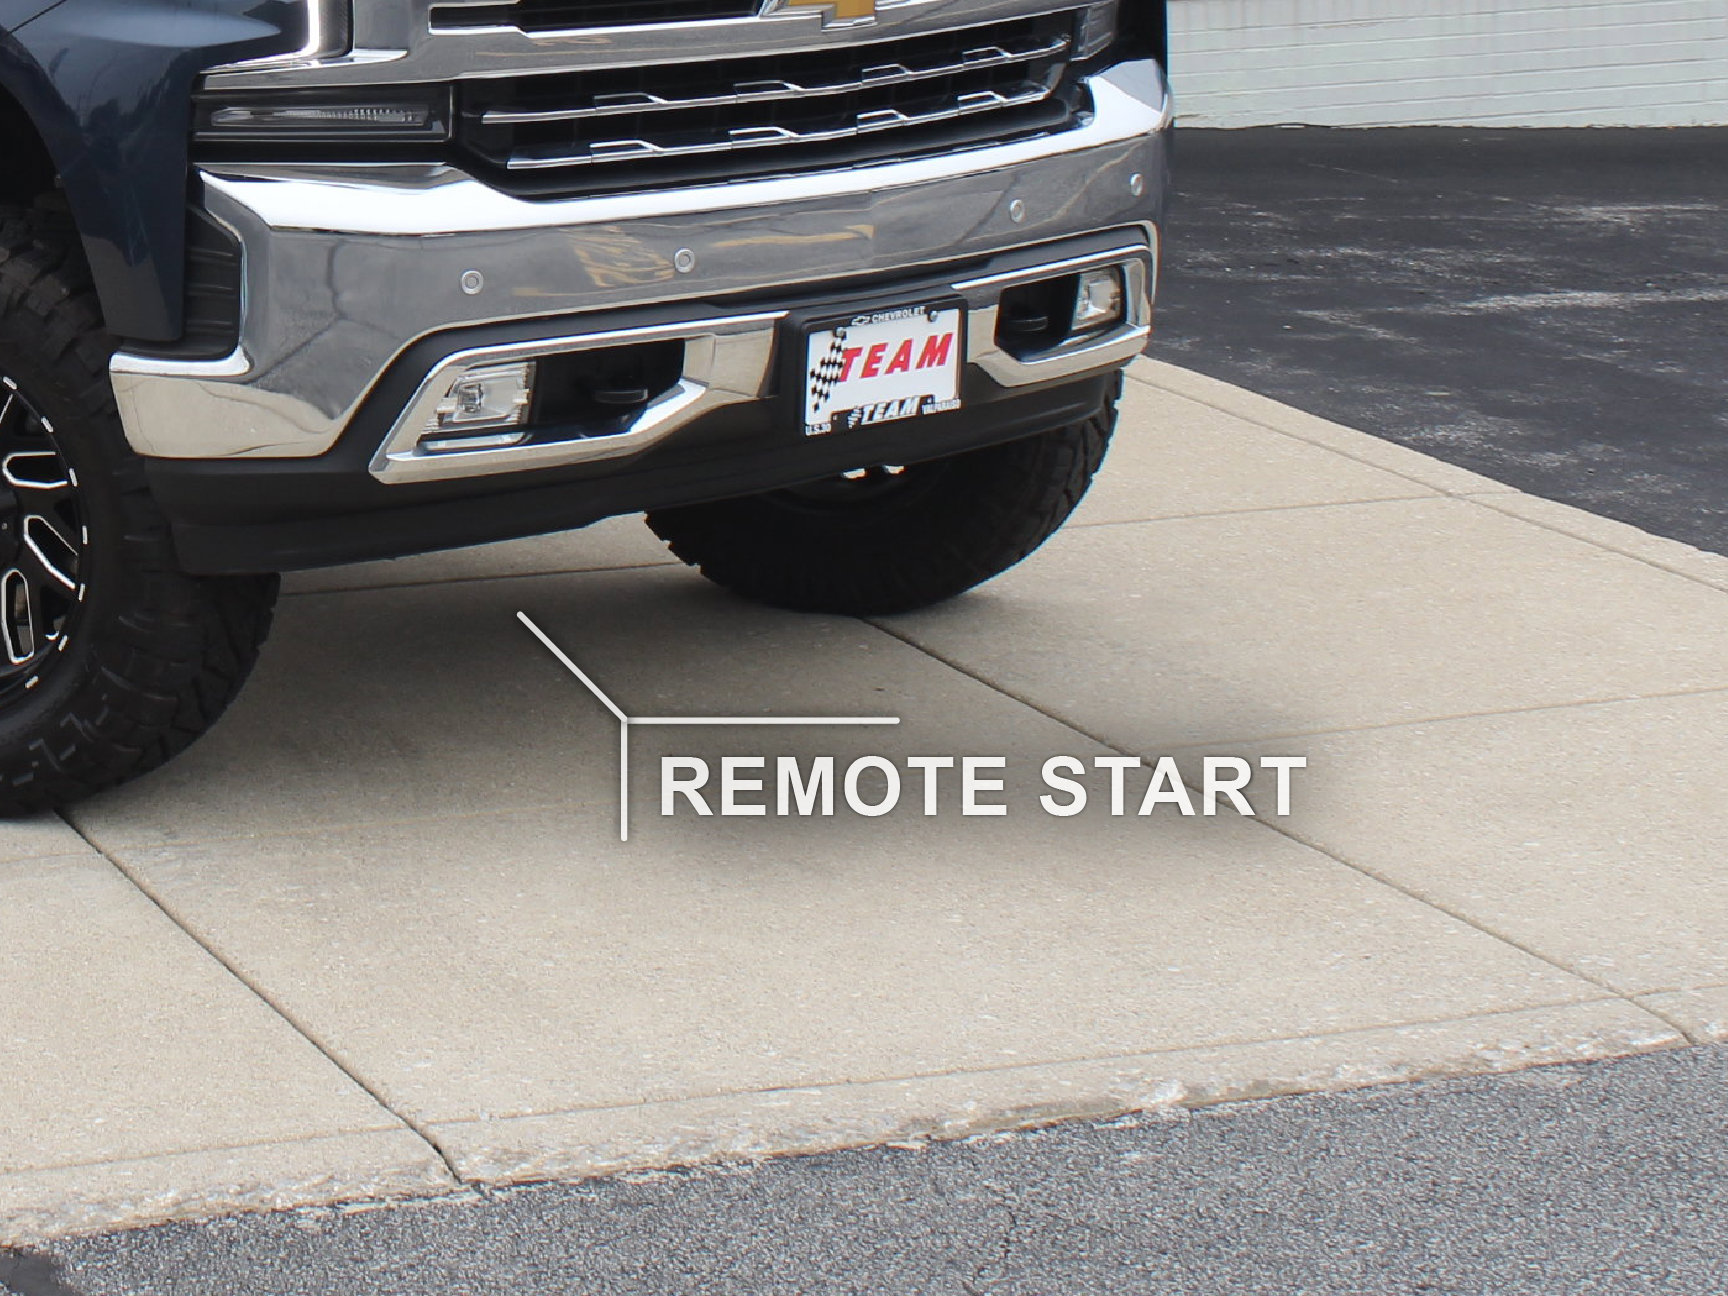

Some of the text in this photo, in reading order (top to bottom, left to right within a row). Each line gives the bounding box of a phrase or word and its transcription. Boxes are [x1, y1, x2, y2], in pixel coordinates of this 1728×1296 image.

[872, 305, 926, 323] CHEVROLET
[839, 333, 953, 382] TEAM
[860, 396, 919, 425] TEAM
